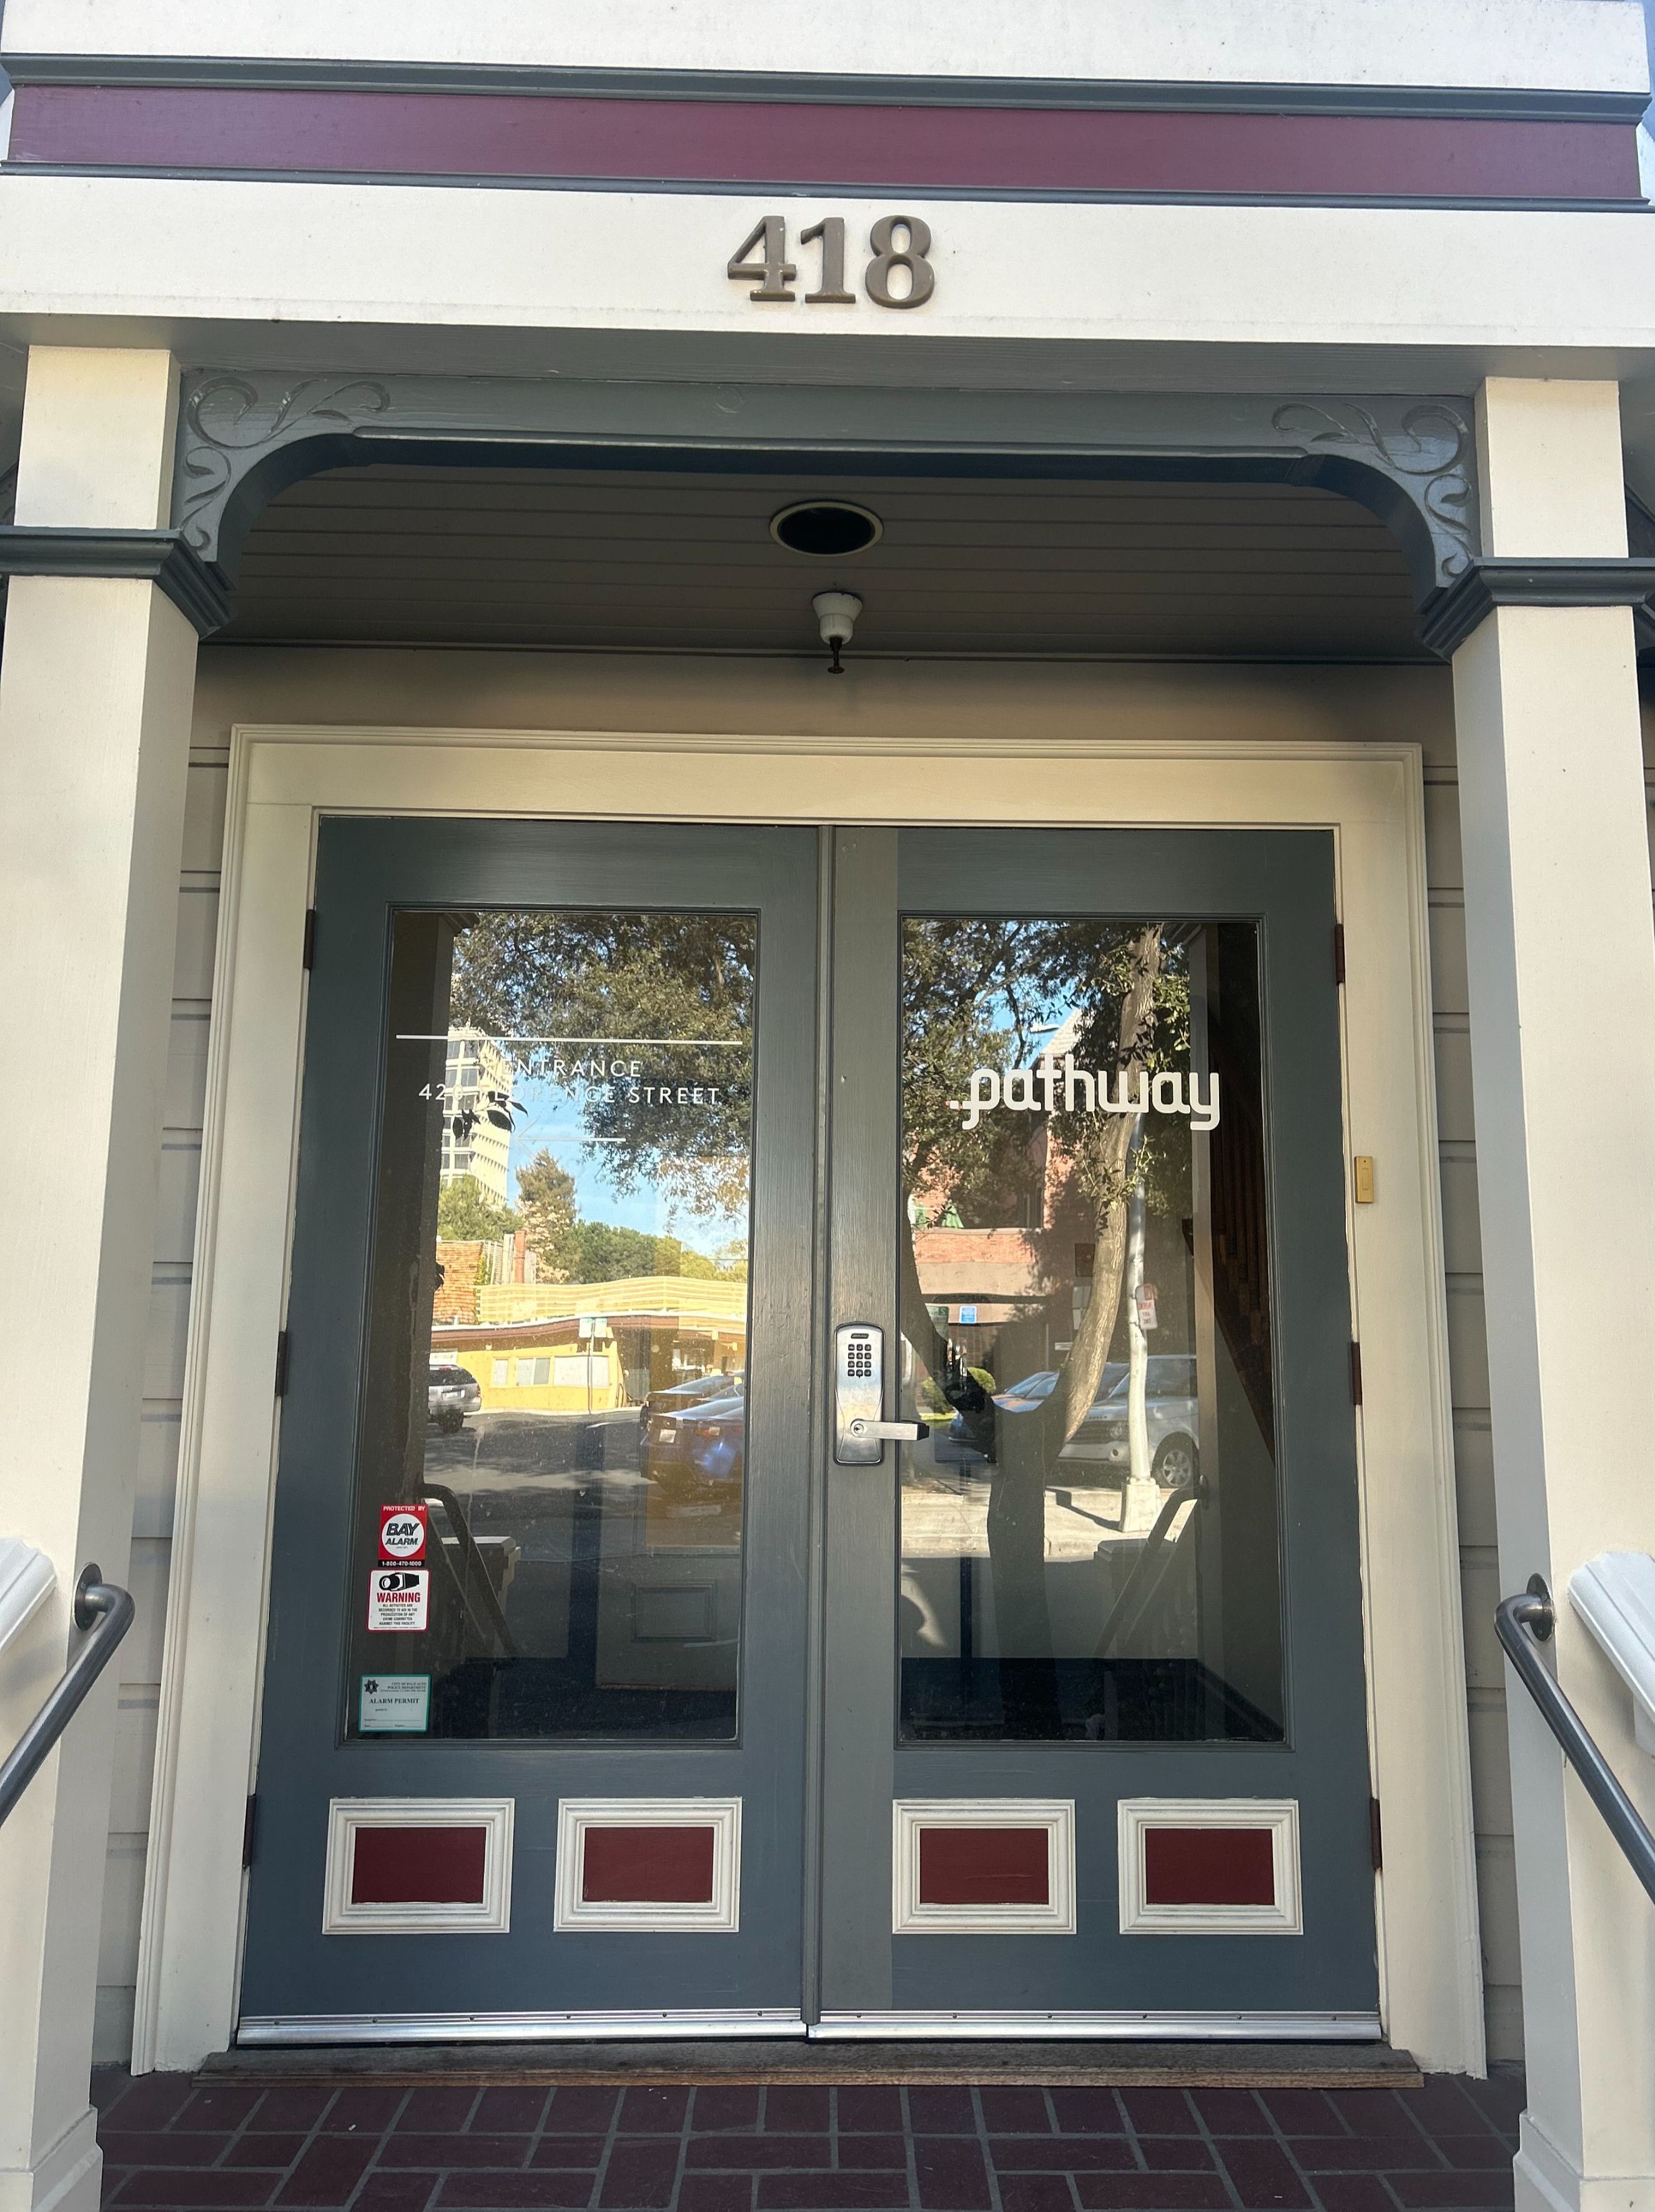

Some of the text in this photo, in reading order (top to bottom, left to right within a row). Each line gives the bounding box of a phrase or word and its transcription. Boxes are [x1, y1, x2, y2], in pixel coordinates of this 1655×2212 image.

[728, 215, 935, 309] 418
[501, 1059, 642, 1077] ENTRANCE
[418, 1083, 463, 1101] 420
[629, 1087, 719, 1105] STREET
[951, 1054, 1220, 1131] pathway
[386, 1523, 420, 1536] BAY
[377, 1592, 421, 1603] WARNING
